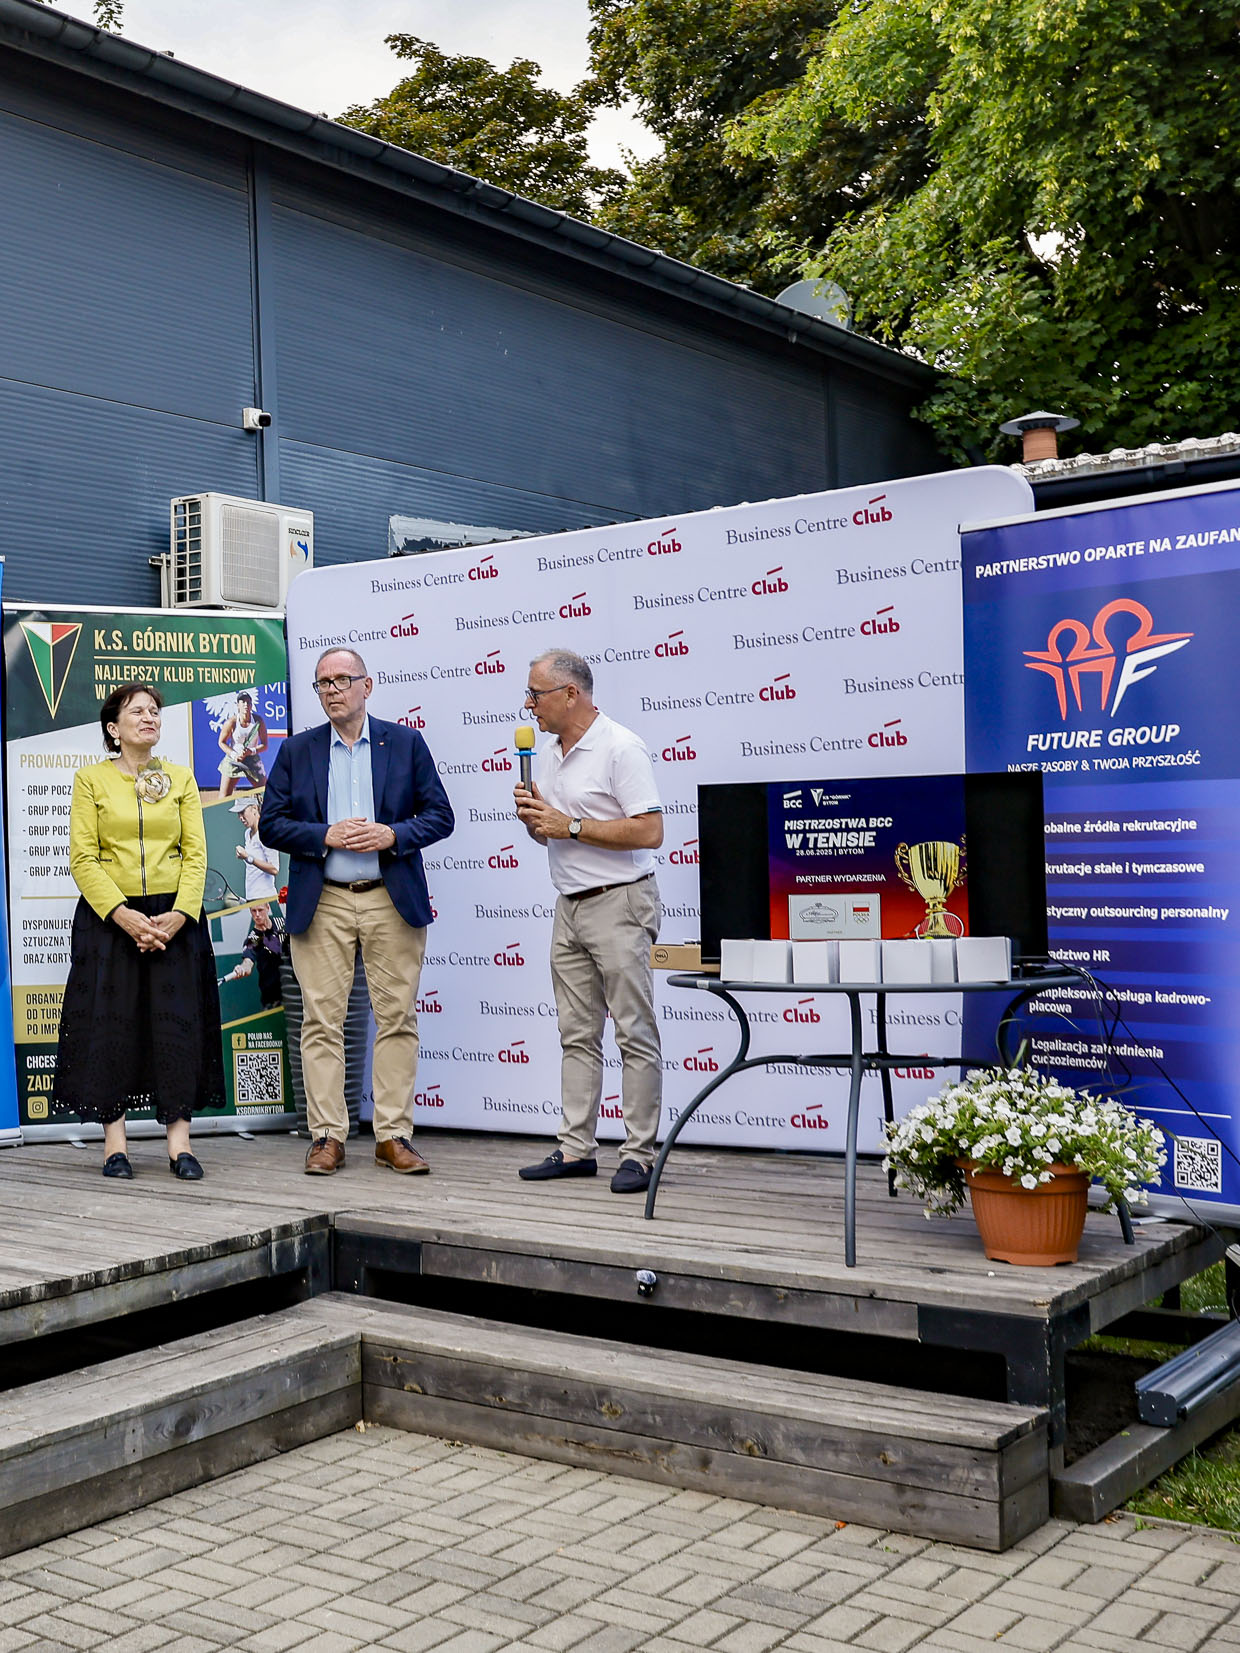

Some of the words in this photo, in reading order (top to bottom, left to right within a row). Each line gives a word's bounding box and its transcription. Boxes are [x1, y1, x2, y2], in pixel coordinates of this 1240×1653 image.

[725, 525, 791, 545] Business
[794, 517, 848, 535] Centre
[852, 507, 893, 526] Club
[537, 550, 594, 572] Business
[597, 545, 643, 563] Centre
[647, 539, 682, 556] Club
[975, 551, 1080, 578] PARTNERSTWO
[1084, 541, 1145, 562] OPARTE
[1149, 537, 1172, 552] NA
[1175, 527, 1240, 549] ZAUFAN
[371, 576, 421, 594] Business
[423, 571, 465, 587] Centre
[468, 565, 499, 582] Club
[835, 565, 907, 586] Business
[633, 592, 695, 610] Business
[697, 585, 747, 603] Centre
[751, 578, 789, 596] Club
[455, 615, 509, 632] Business
[512, 609, 556, 625] Centre
[559, 603, 592, 619] Club
[94, 630, 128, 651] K.S.
[133, 627, 195, 654] GÓRNIK
[199, 633, 256, 655] BYTOM
[299, 634, 347, 651] Business
[348, 628, 387, 644] Centre
[390, 623, 419, 638] Club
[733, 632, 799, 651] Business
[802, 624, 856, 643] Centre
[860, 617, 900, 636] Club
[603, 646, 650, 663] Centre
[654, 641, 689, 659] Club
[94, 664, 160, 682] NAJLEPSZY
[164, 666, 194, 683] KLUB
[198, 667, 256, 684] TENISOWY
[377, 669, 428, 685] Business
[430, 665, 471, 681] Centre
[474, 659, 505, 675] Club
[95, 684, 107, 700] W
[843, 675, 914, 695] Business
[641, 695, 702, 712] Business
[705, 689, 755, 708] Centre
[759, 685, 796, 702] Club
[740, 740, 807, 757] Business
[810, 735, 863, 753] Centre
[867, 730, 908, 748] Club
[1026, 729, 1102, 752] FUTURE
[1107, 723, 1180, 747] GROUP
[20, 753, 101, 768] PROWADZIMY
[481, 757, 512, 773] Club
[1041, 760, 1079, 773] ZASOBY
[1081, 760, 1091, 771] &
[1093, 757, 1130, 770] TWOJA
[1132, 749, 1201, 767] PRZYSZŁOŚĆ
[27, 785, 50, 796] GRUP
[51, 784, 72, 795] POCZ
[28, 805, 50, 816] GRUP
[783, 800, 803, 808] BCC
[28, 825, 50, 837] GRUP
[784, 817, 867, 831] MISTRZOSTWA
[869, 817, 893, 828] BCC
[1044, 821, 1082, 834] obalne
[1084, 819, 1120, 833] źródła
[1123, 818, 1197, 833] rekrutacyjne
[785, 833, 804, 849] W
[806, 831, 877, 849] TENISIE
[29, 846, 51, 857] GRUP
[29, 866, 51, 877] GRUP
[1045, 862, 1092, 876] krutacje
[1094, 861, 1123, 874] stałe
[1125, 861, 1130, 874] i
[1132, 861, 1205, 876] tymczasowe
[795, 875, 832, 884] PARTNER
[833, 874, 886, 883] WYDARZENIA
[1046, 906, 1088, 920] styczny
[1090, 905, 1158, 920] outsourcing
[1161, 906, 1230, 921] personalny
[23, 936, 65, 948] SZTUCZNA
[23, 953, 45, 964] ORAZ
[1048, 950, 1090, 962] adztwo
[1093, 950, 1110, 961] HR
[1037, 987, 1104, 1001] ompleksowa
[1106, 989, 1152, 1004] obsługa
[1155, 991, 1212, 1006] kadrowo-
[26, 1009, 38, 1021] OD
[662, 1005, 725, 1023] Business
[782, 1008, 821, 1024] Club
[1029, 1001, 1073, 1015] płacowa
[27, 1024, 39, 1035] PO
[1031, 1038, 1088, 1054] Legalizacja
[1091, 1043, 1164, 1059] zatrudnienia
[735, 1112, 786, 1129] Centre
[790, 1113, 829, 1130] Club
